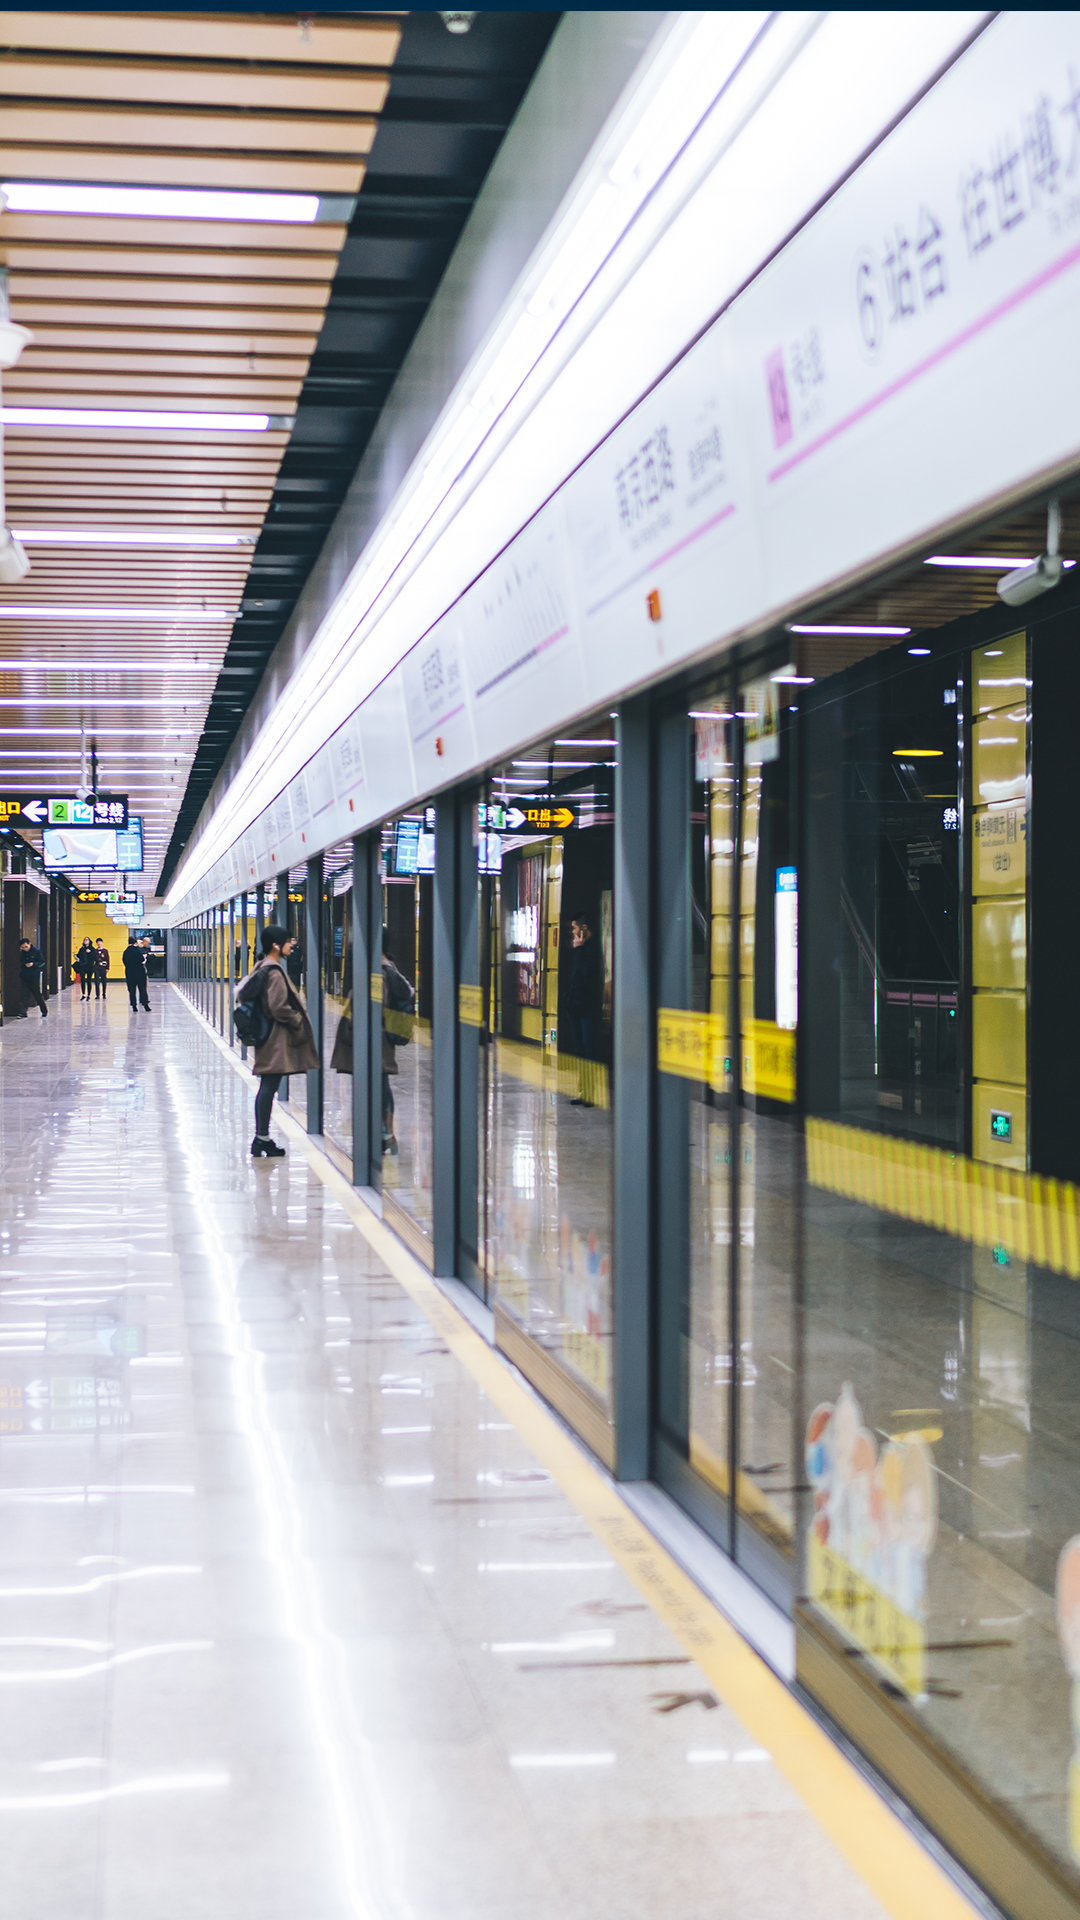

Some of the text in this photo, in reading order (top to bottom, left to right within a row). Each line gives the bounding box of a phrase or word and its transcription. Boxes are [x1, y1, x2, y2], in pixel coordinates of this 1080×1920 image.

[54, 802, 125, 819] 2 12 号线
